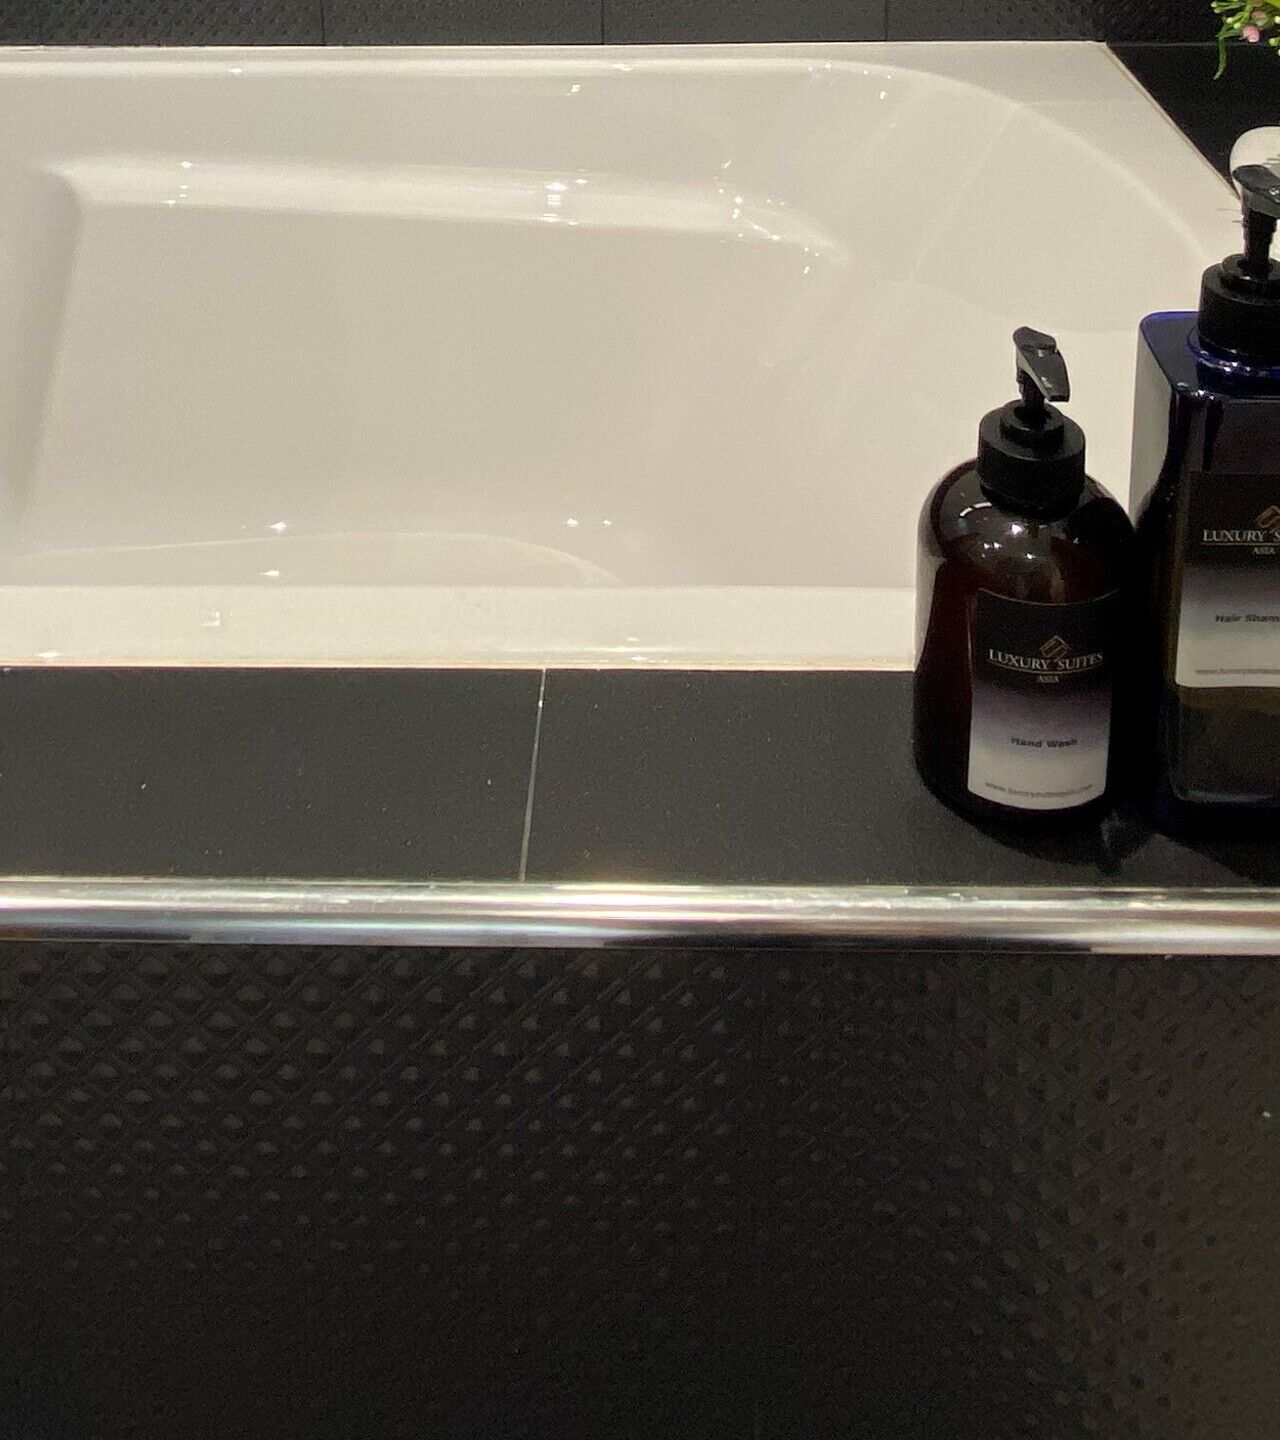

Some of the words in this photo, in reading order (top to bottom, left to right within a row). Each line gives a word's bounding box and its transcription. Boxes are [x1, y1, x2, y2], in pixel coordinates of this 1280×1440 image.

[1203, 529, 1265, 542] LUXURY
[989, 648, 1049, 670] LUXURY
[1055, 652, 1104, 670] SUITES
